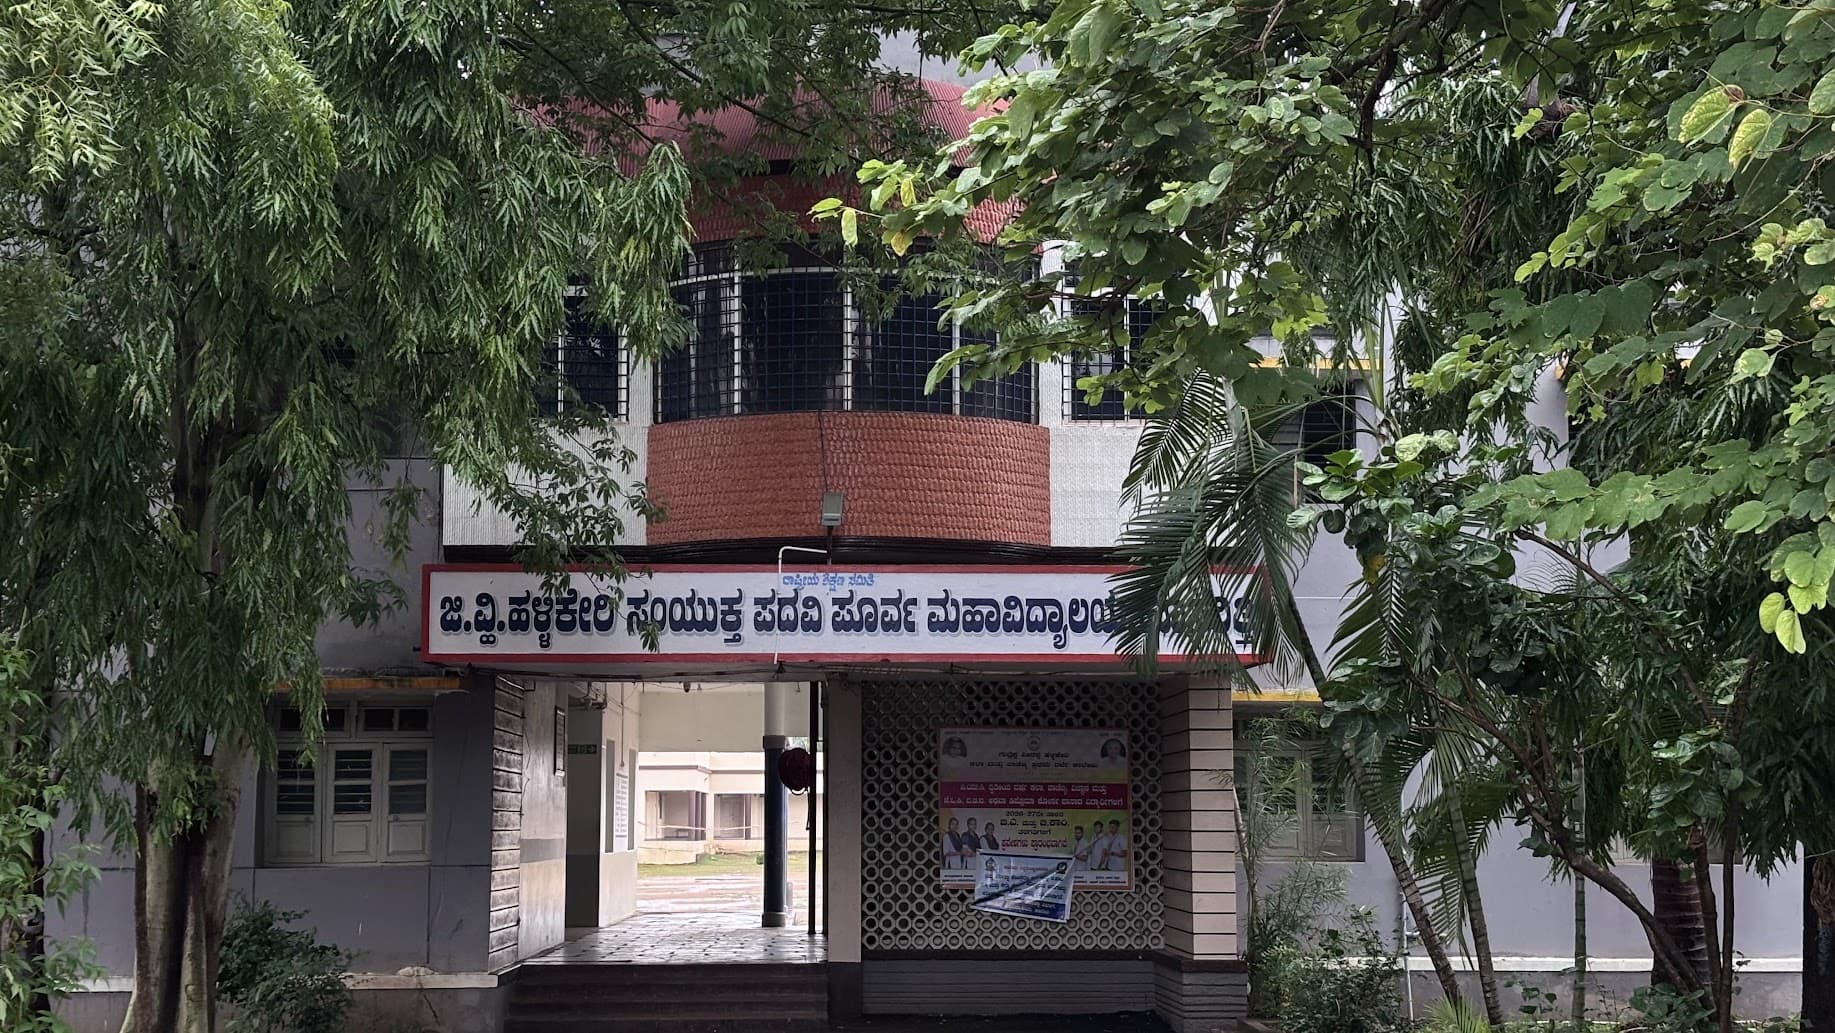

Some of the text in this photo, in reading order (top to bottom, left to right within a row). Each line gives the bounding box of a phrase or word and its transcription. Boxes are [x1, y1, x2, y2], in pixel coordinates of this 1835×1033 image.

[822, 572, 845, 591] ಶಿಕ್ಷಣ
[848, 573, 875, 586] ಸಮಿತಿ
[627, 588, 743, 644] ಸಂಯುಕ್ತ
[753, 588, 823, 634] ಪದವಿ
[832, 589, 918, 635] ಪೂರ್ವ
